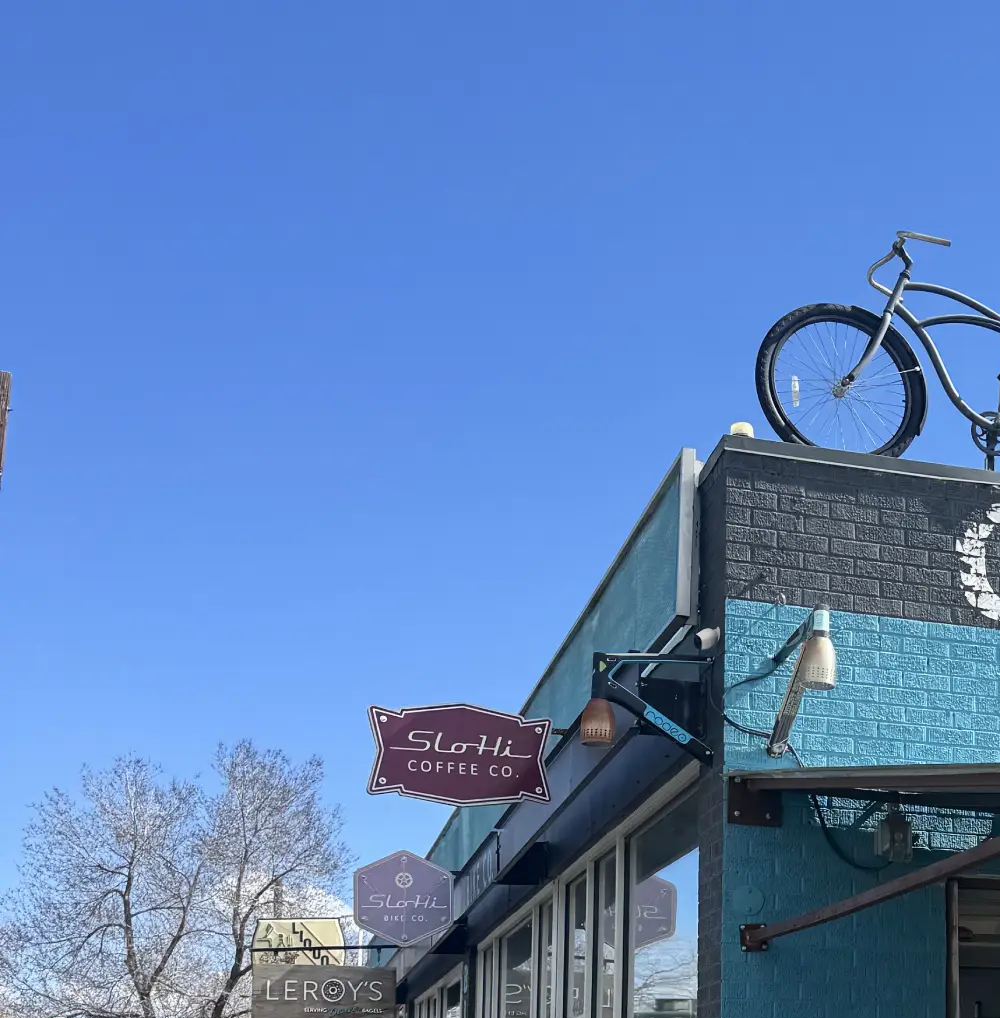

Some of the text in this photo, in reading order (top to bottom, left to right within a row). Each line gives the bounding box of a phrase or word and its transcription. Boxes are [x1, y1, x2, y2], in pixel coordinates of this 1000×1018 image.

[390, 730, 532, 759] SloHi
[407, 759, 520, 778] COFFEE CO.
[361, 894, 448, 909] SloHi
[383, 914, 428, 922] BIKE CO.
[266, 978, 383, 1002] LEROY'S
